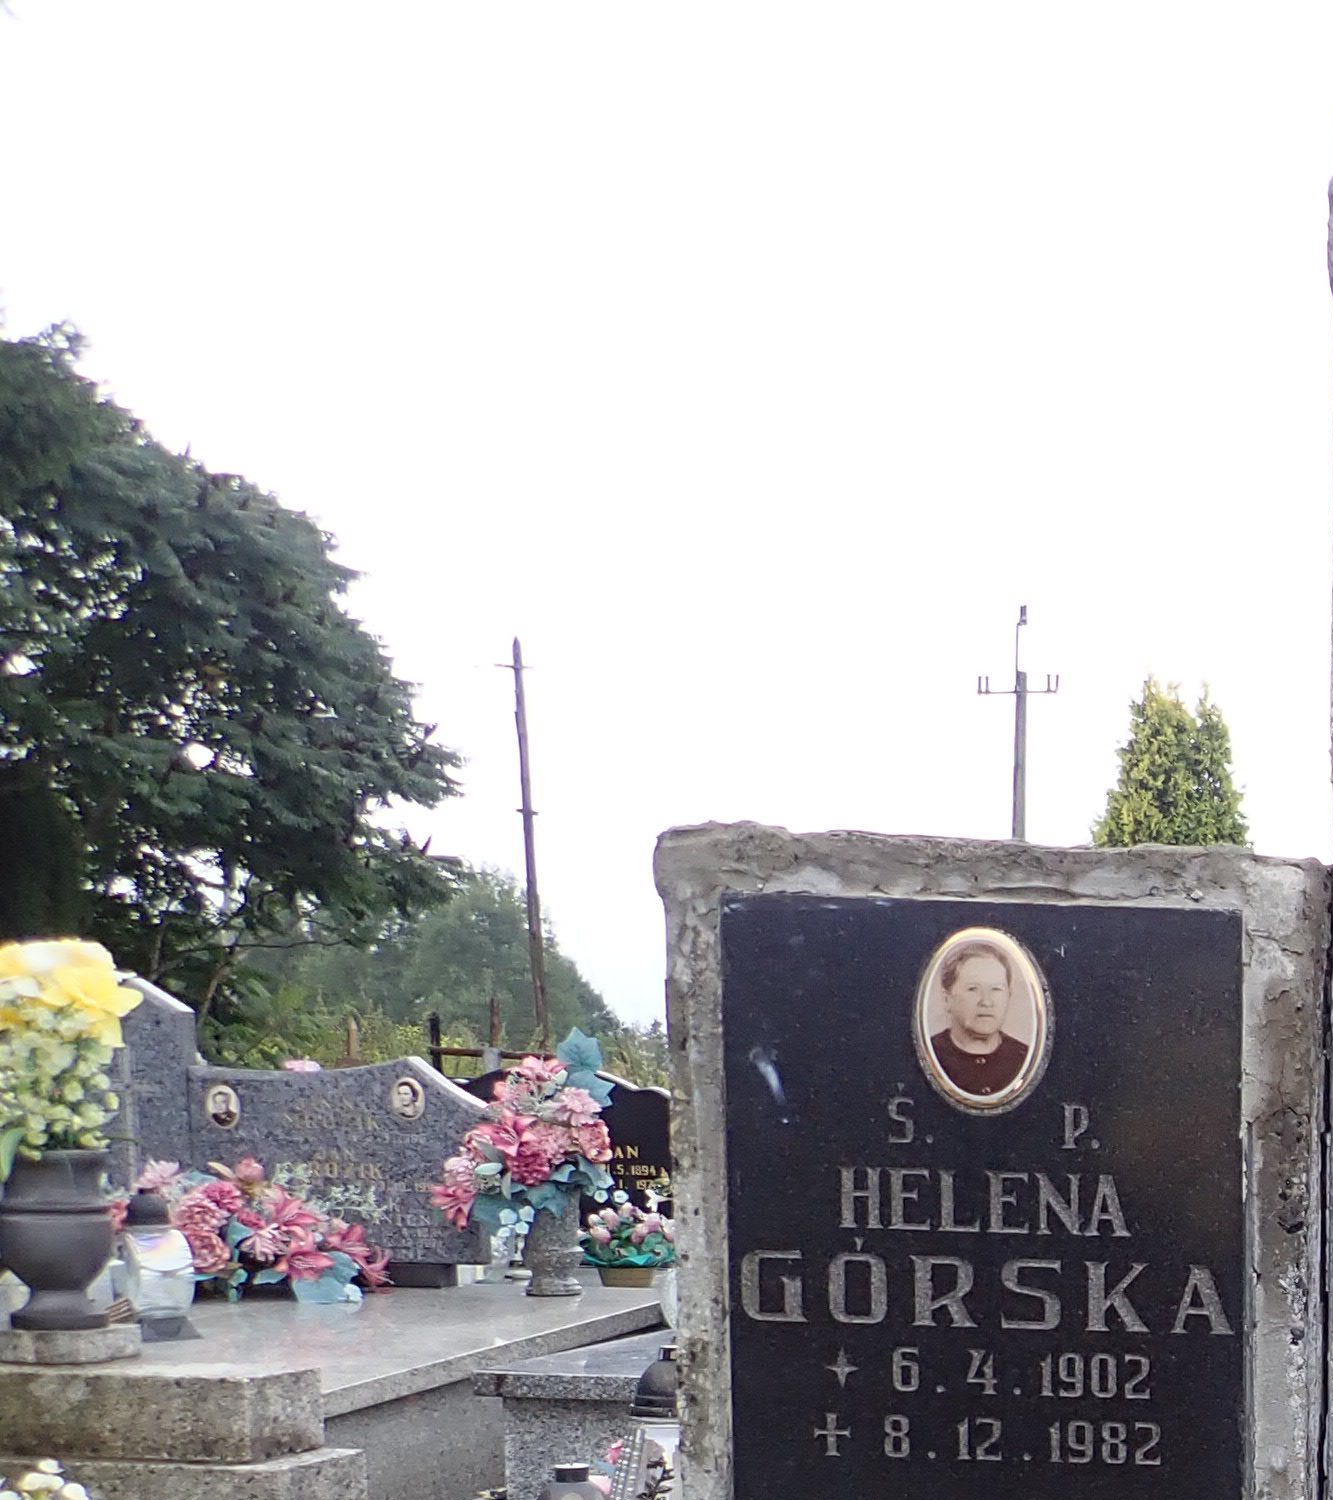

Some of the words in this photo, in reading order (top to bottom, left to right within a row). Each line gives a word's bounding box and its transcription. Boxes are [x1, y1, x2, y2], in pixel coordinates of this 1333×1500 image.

[887, 1080, 934, 1143] Ś.
[1060, 1102, 1100, 1149] P.
[838, 1164, 1130, 1238] HELENA
[741, 1238, 1235, 1336] GÓRSKA
